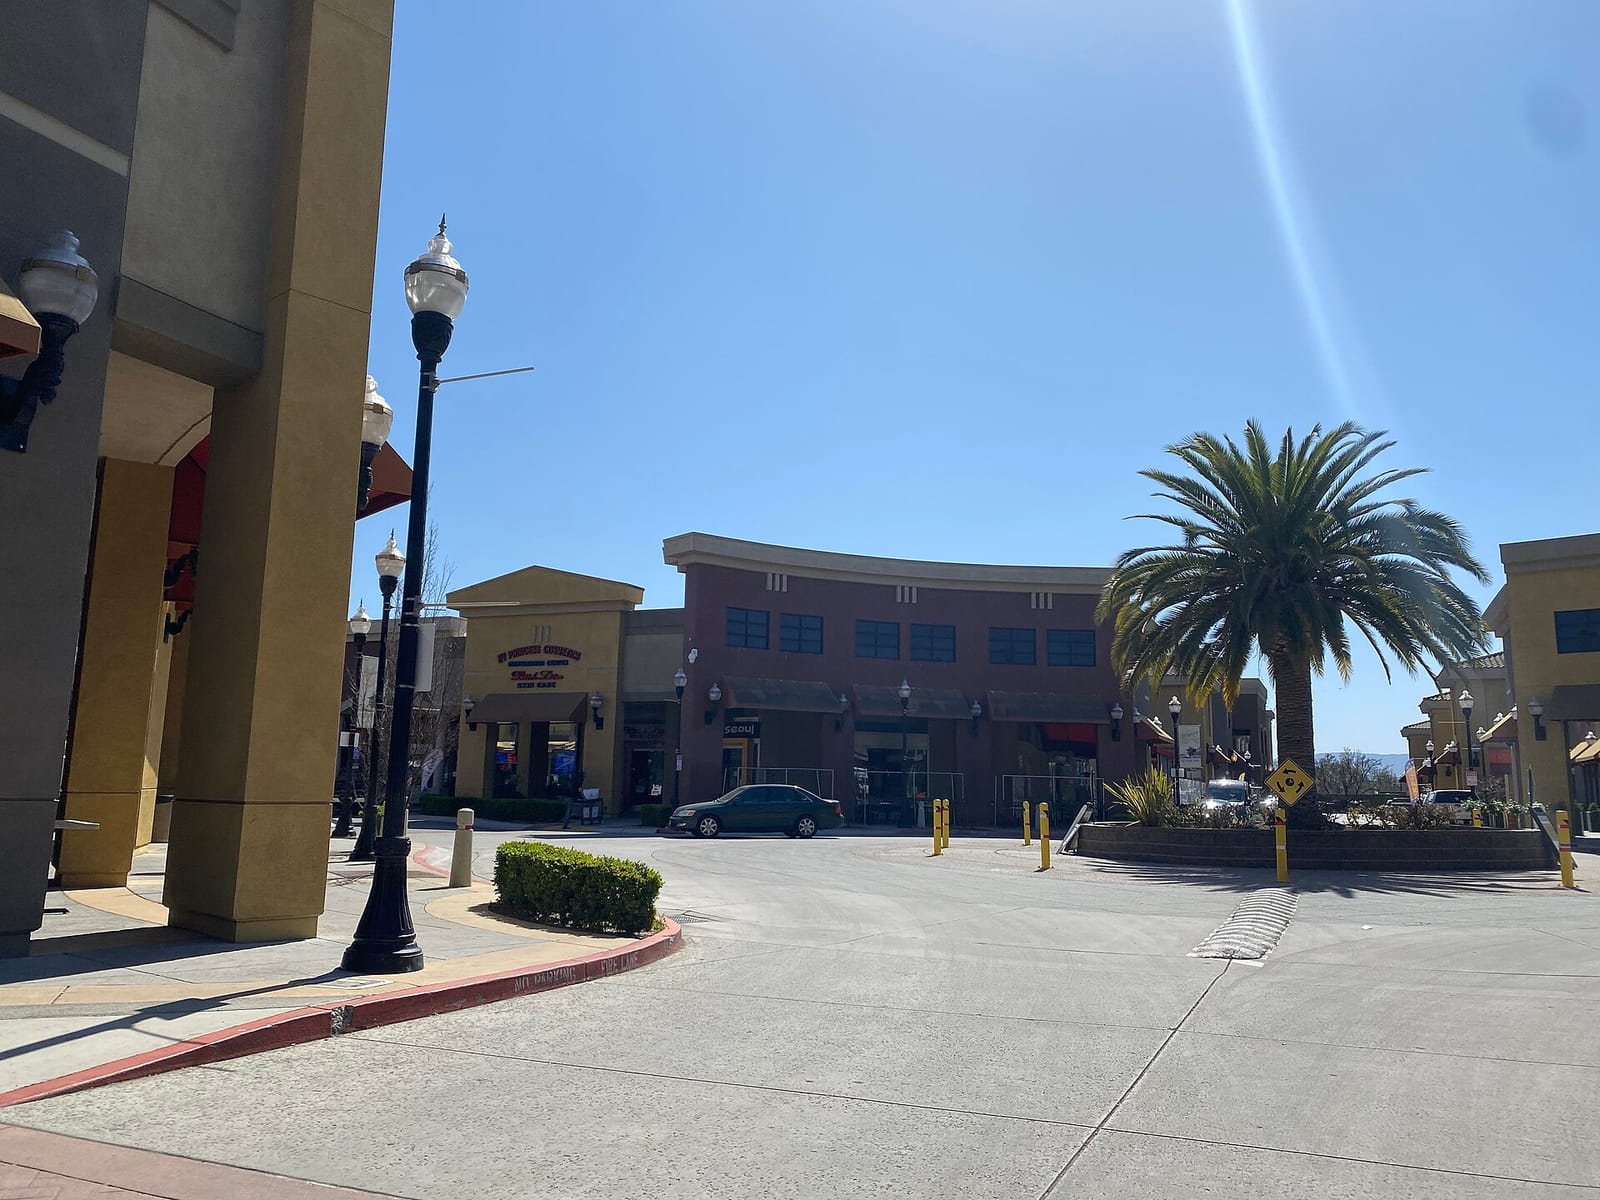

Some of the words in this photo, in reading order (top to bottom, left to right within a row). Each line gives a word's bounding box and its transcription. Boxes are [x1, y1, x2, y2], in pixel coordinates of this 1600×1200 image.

[724, 724, 754, 734] seoul
[514, 976, 529, 992] NO
[534, 967, 577, 985] PARKING
[601, 957, 618, 976] FIRE
[621, 951, 638, 970] LANE
